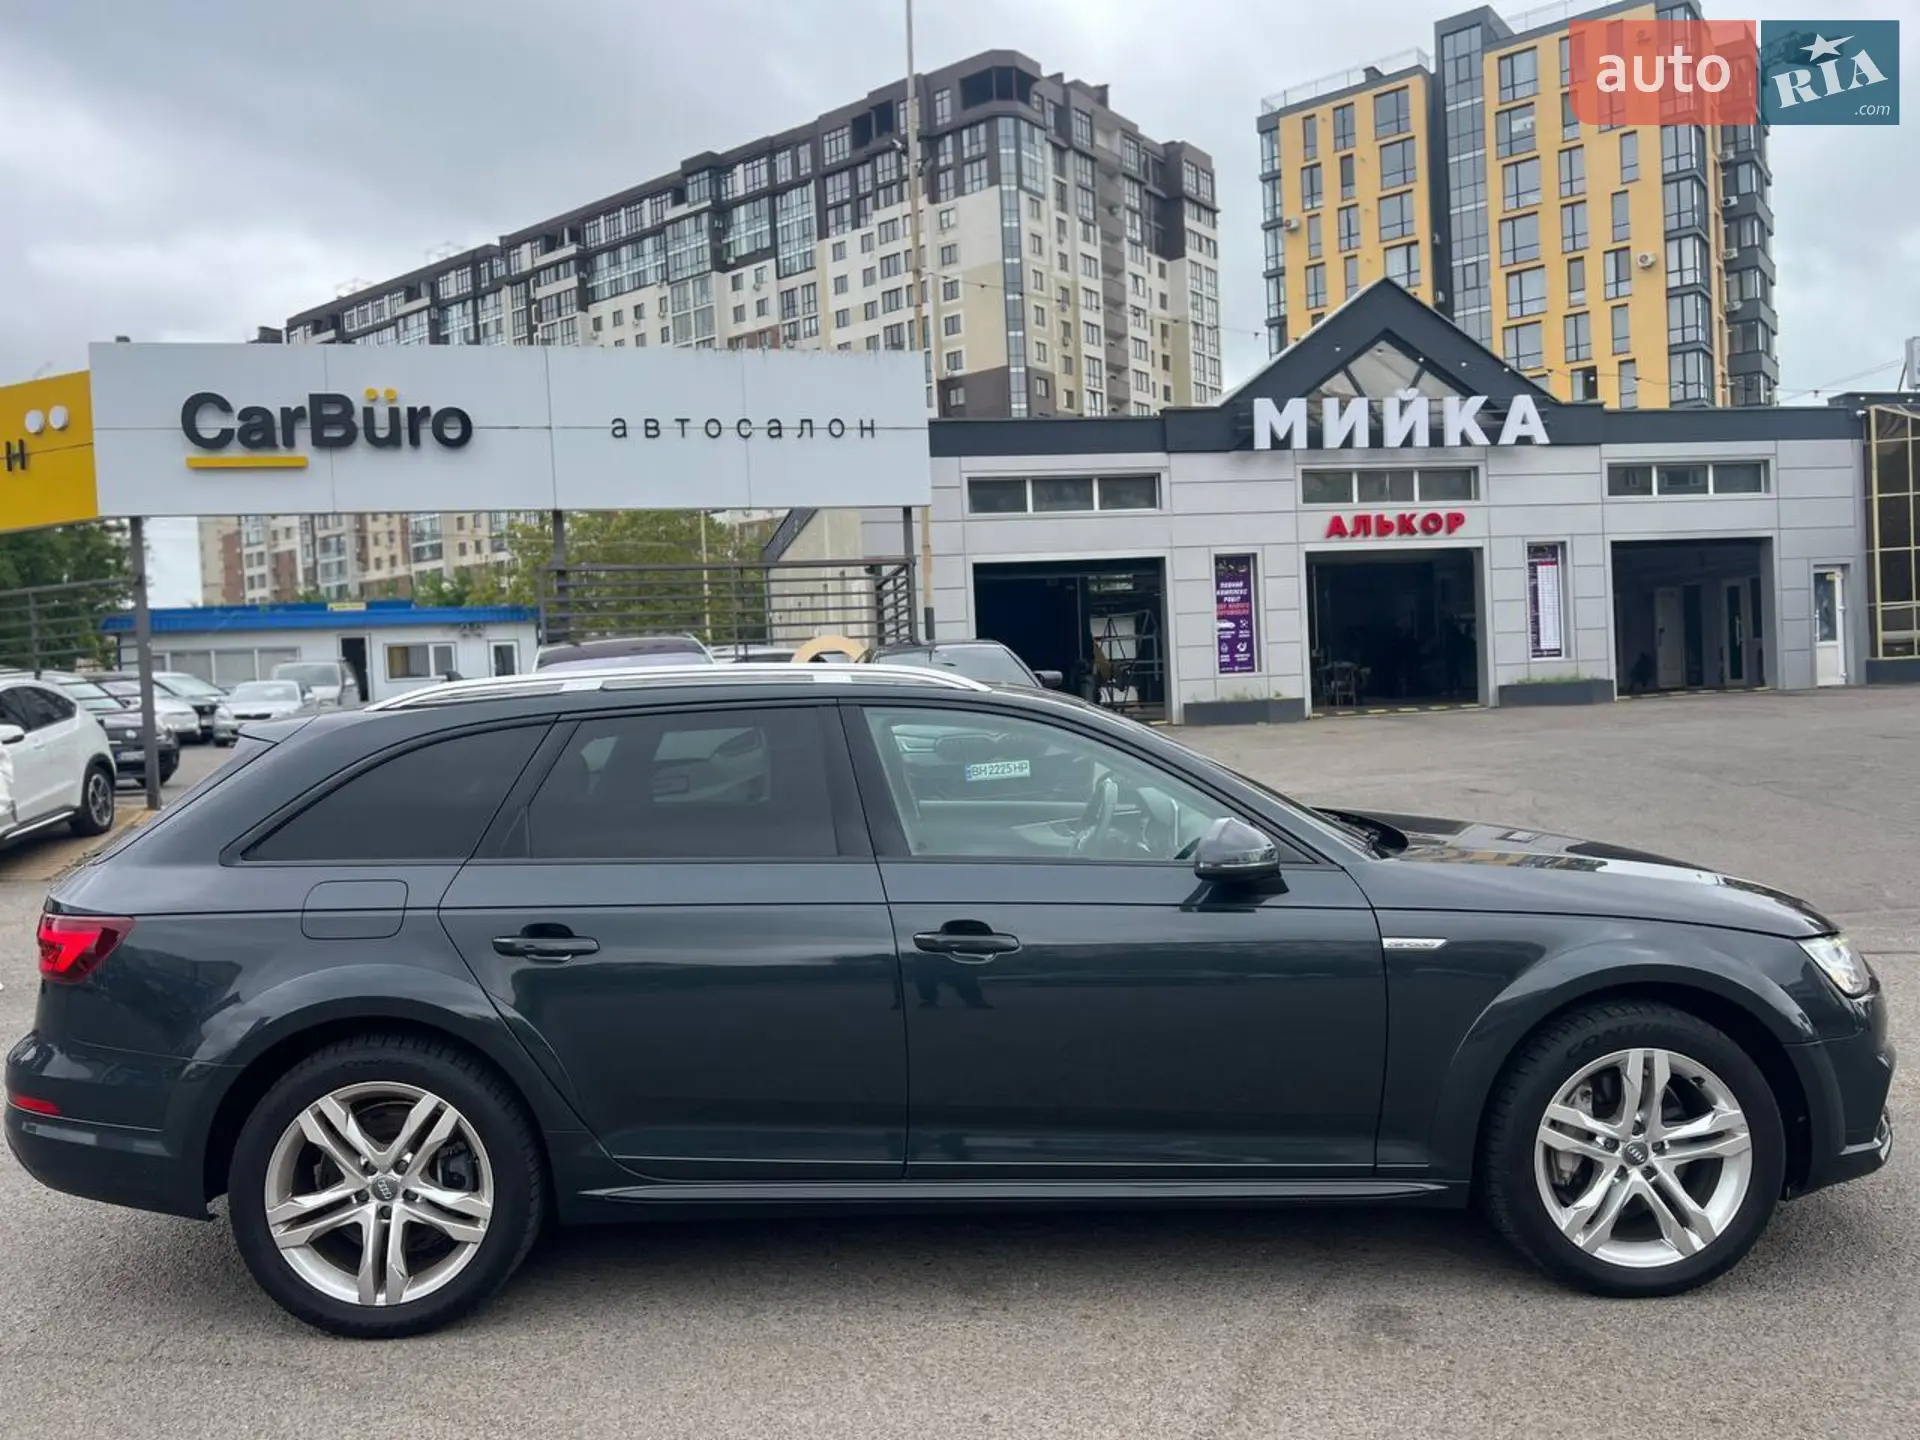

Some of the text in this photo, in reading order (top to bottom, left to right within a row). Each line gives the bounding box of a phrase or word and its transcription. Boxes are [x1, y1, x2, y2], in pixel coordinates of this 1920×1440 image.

[181, 388, 473, 451] CarBüro
[611, 417, 875, 439] автосалон
[1253, 388, 1550, 450] МИЙКА
[1325, 512, 1466, 539] АЛЬКОР
